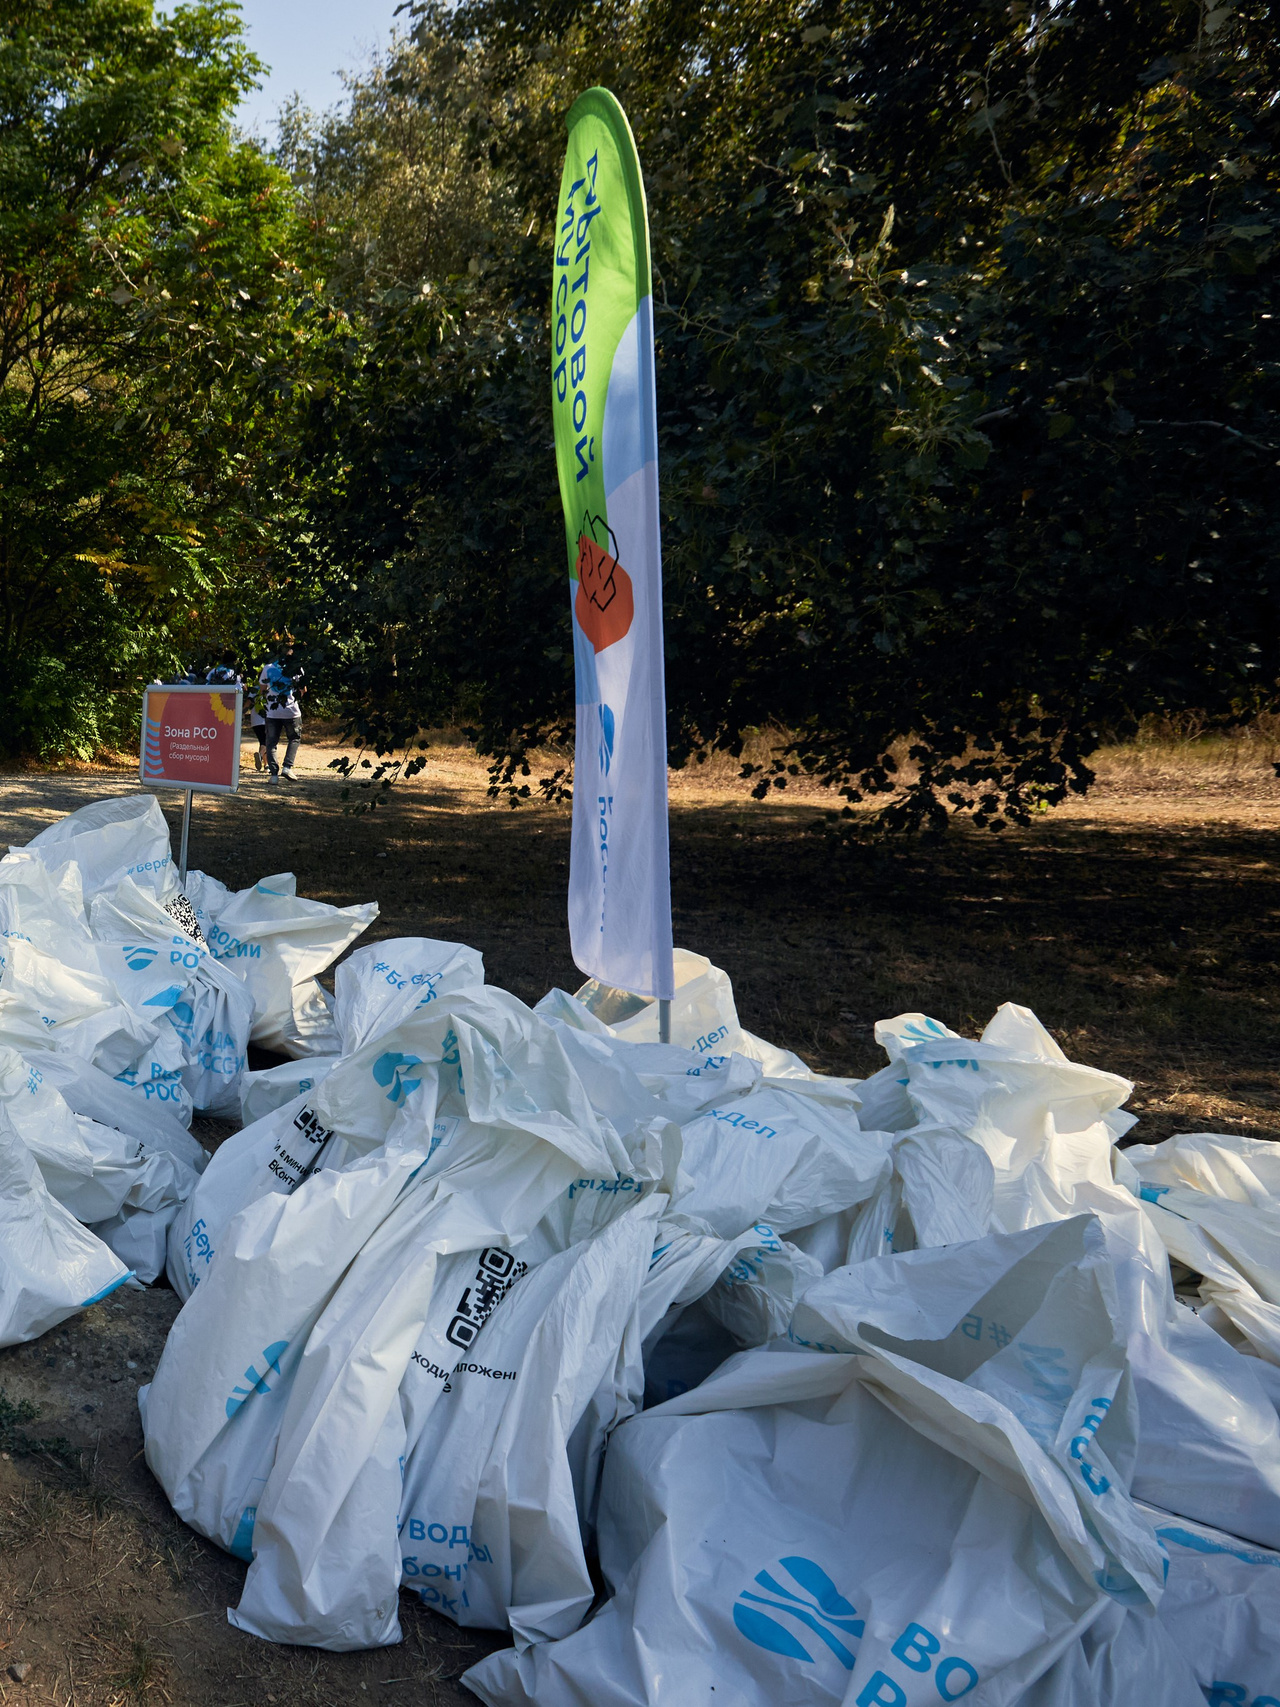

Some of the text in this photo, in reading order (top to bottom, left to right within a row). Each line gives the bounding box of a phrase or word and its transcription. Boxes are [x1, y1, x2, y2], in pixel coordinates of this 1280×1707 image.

[164, 725, 218, 740] Зона РСО
[170, 741, 210, 752] (Раздельный
[169, 751, 210, 763] сбор мусора)
[268, 1159, 297, 1187] ВКонт
[411, 1350, 450, 1382] ходи
